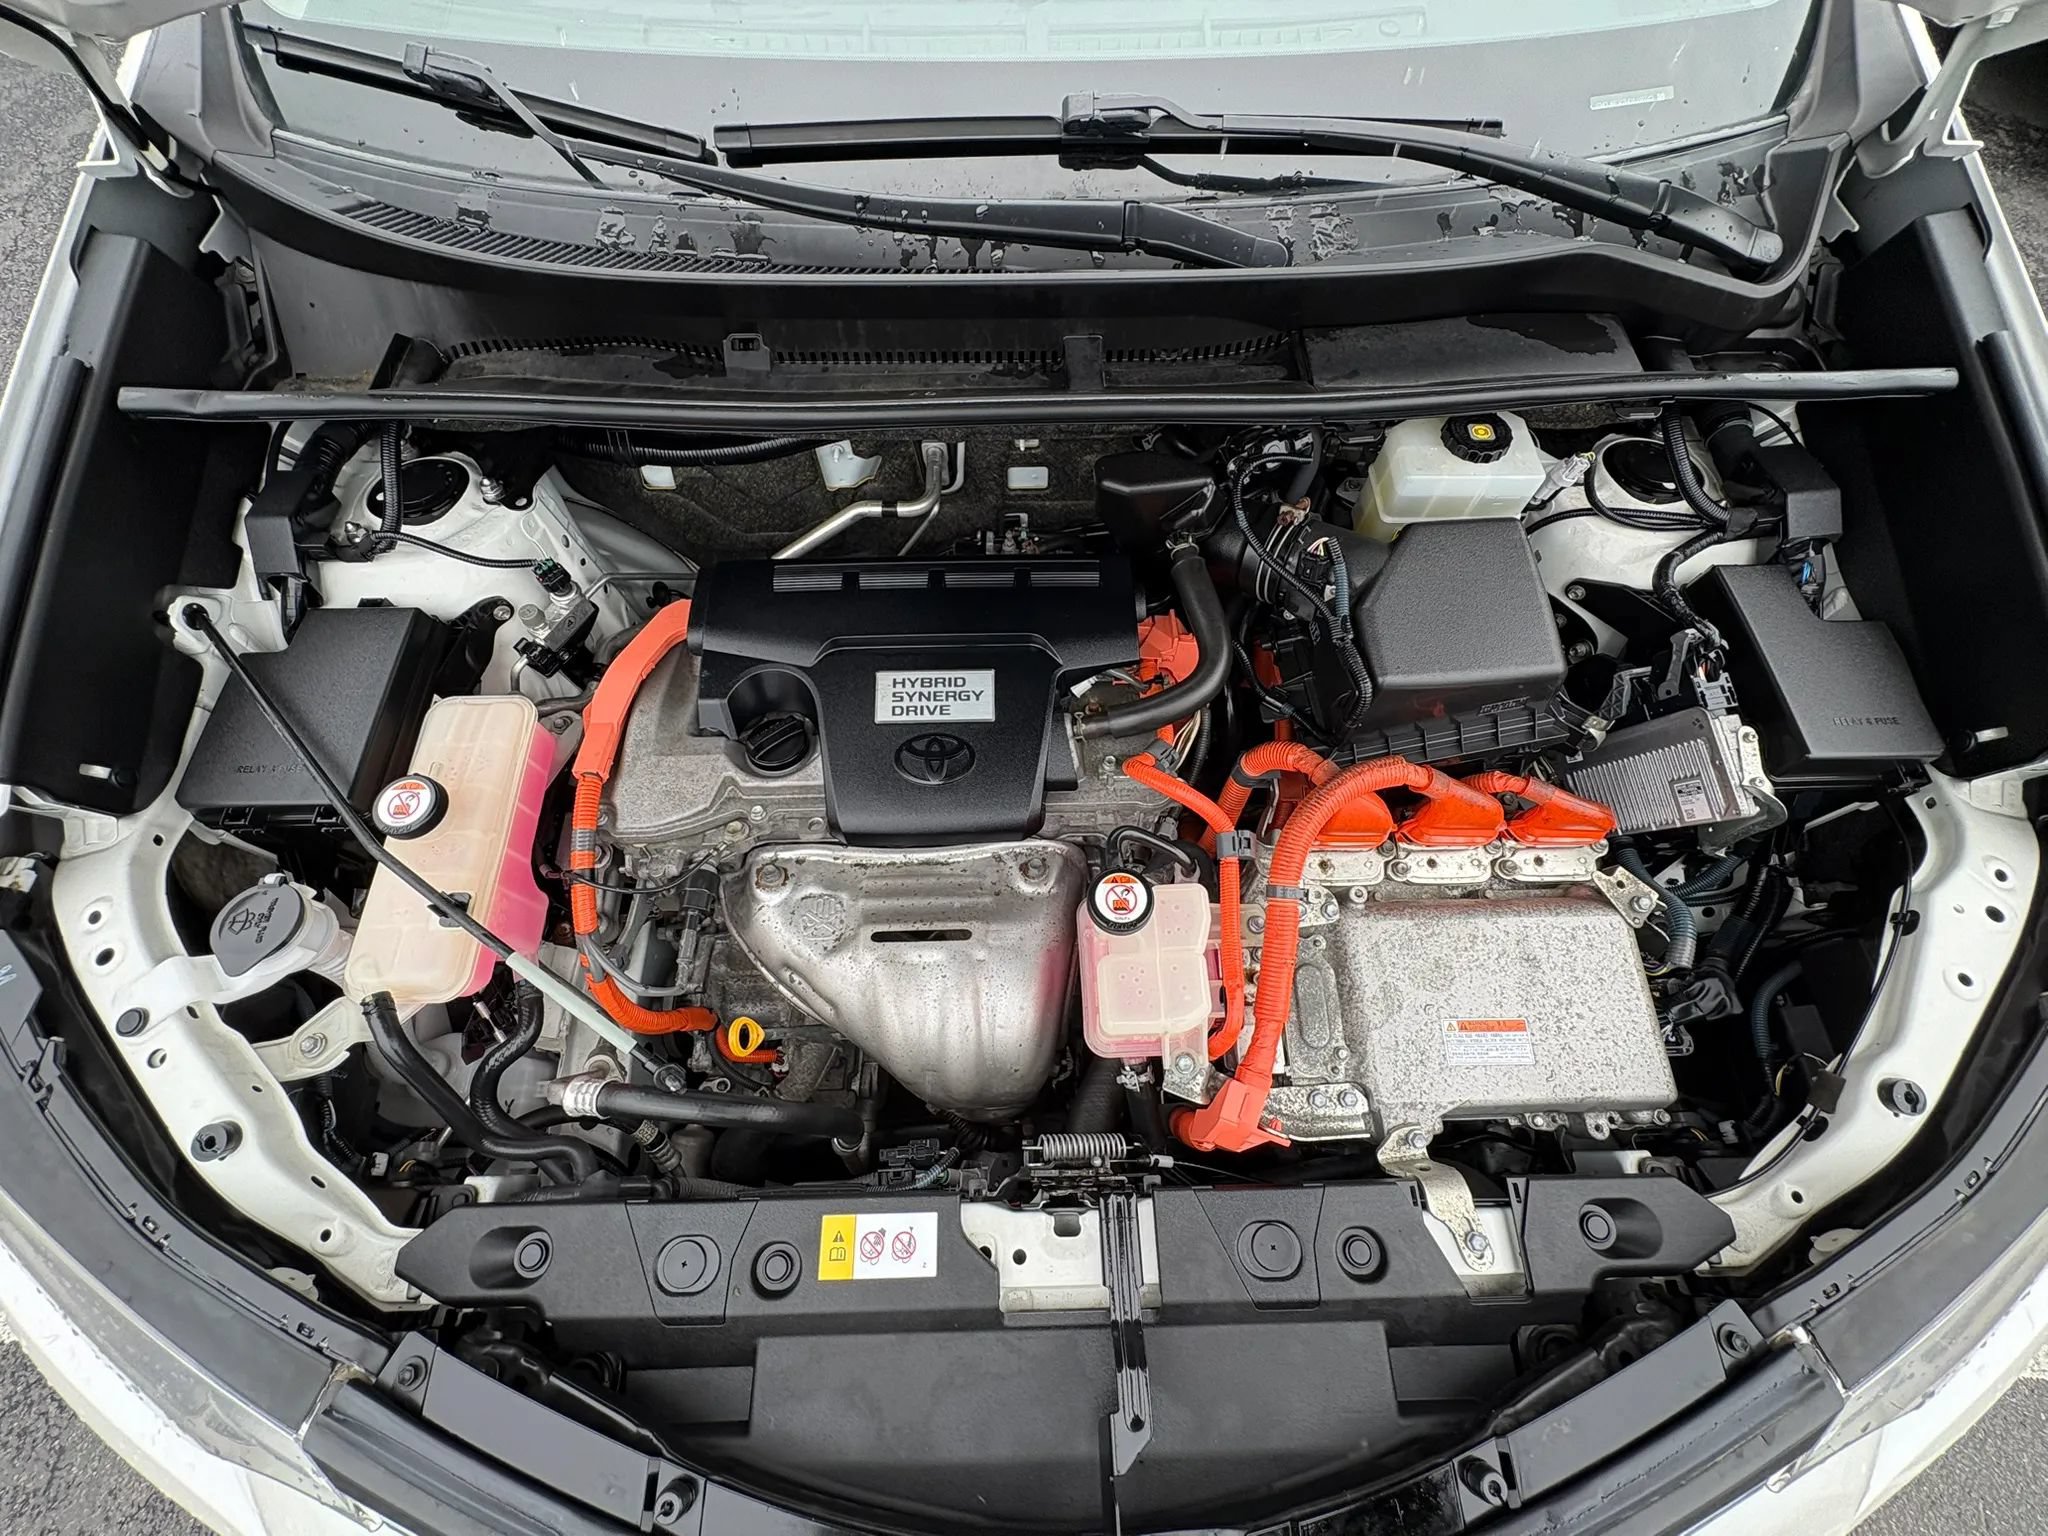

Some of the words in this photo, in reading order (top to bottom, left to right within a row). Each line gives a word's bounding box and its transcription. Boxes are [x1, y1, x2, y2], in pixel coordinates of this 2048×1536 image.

[892, 677, 967, 689] HYBRID
[891, 690, 985, 703] SYNERGY
[891, 704, 952, 717] DRIVE
